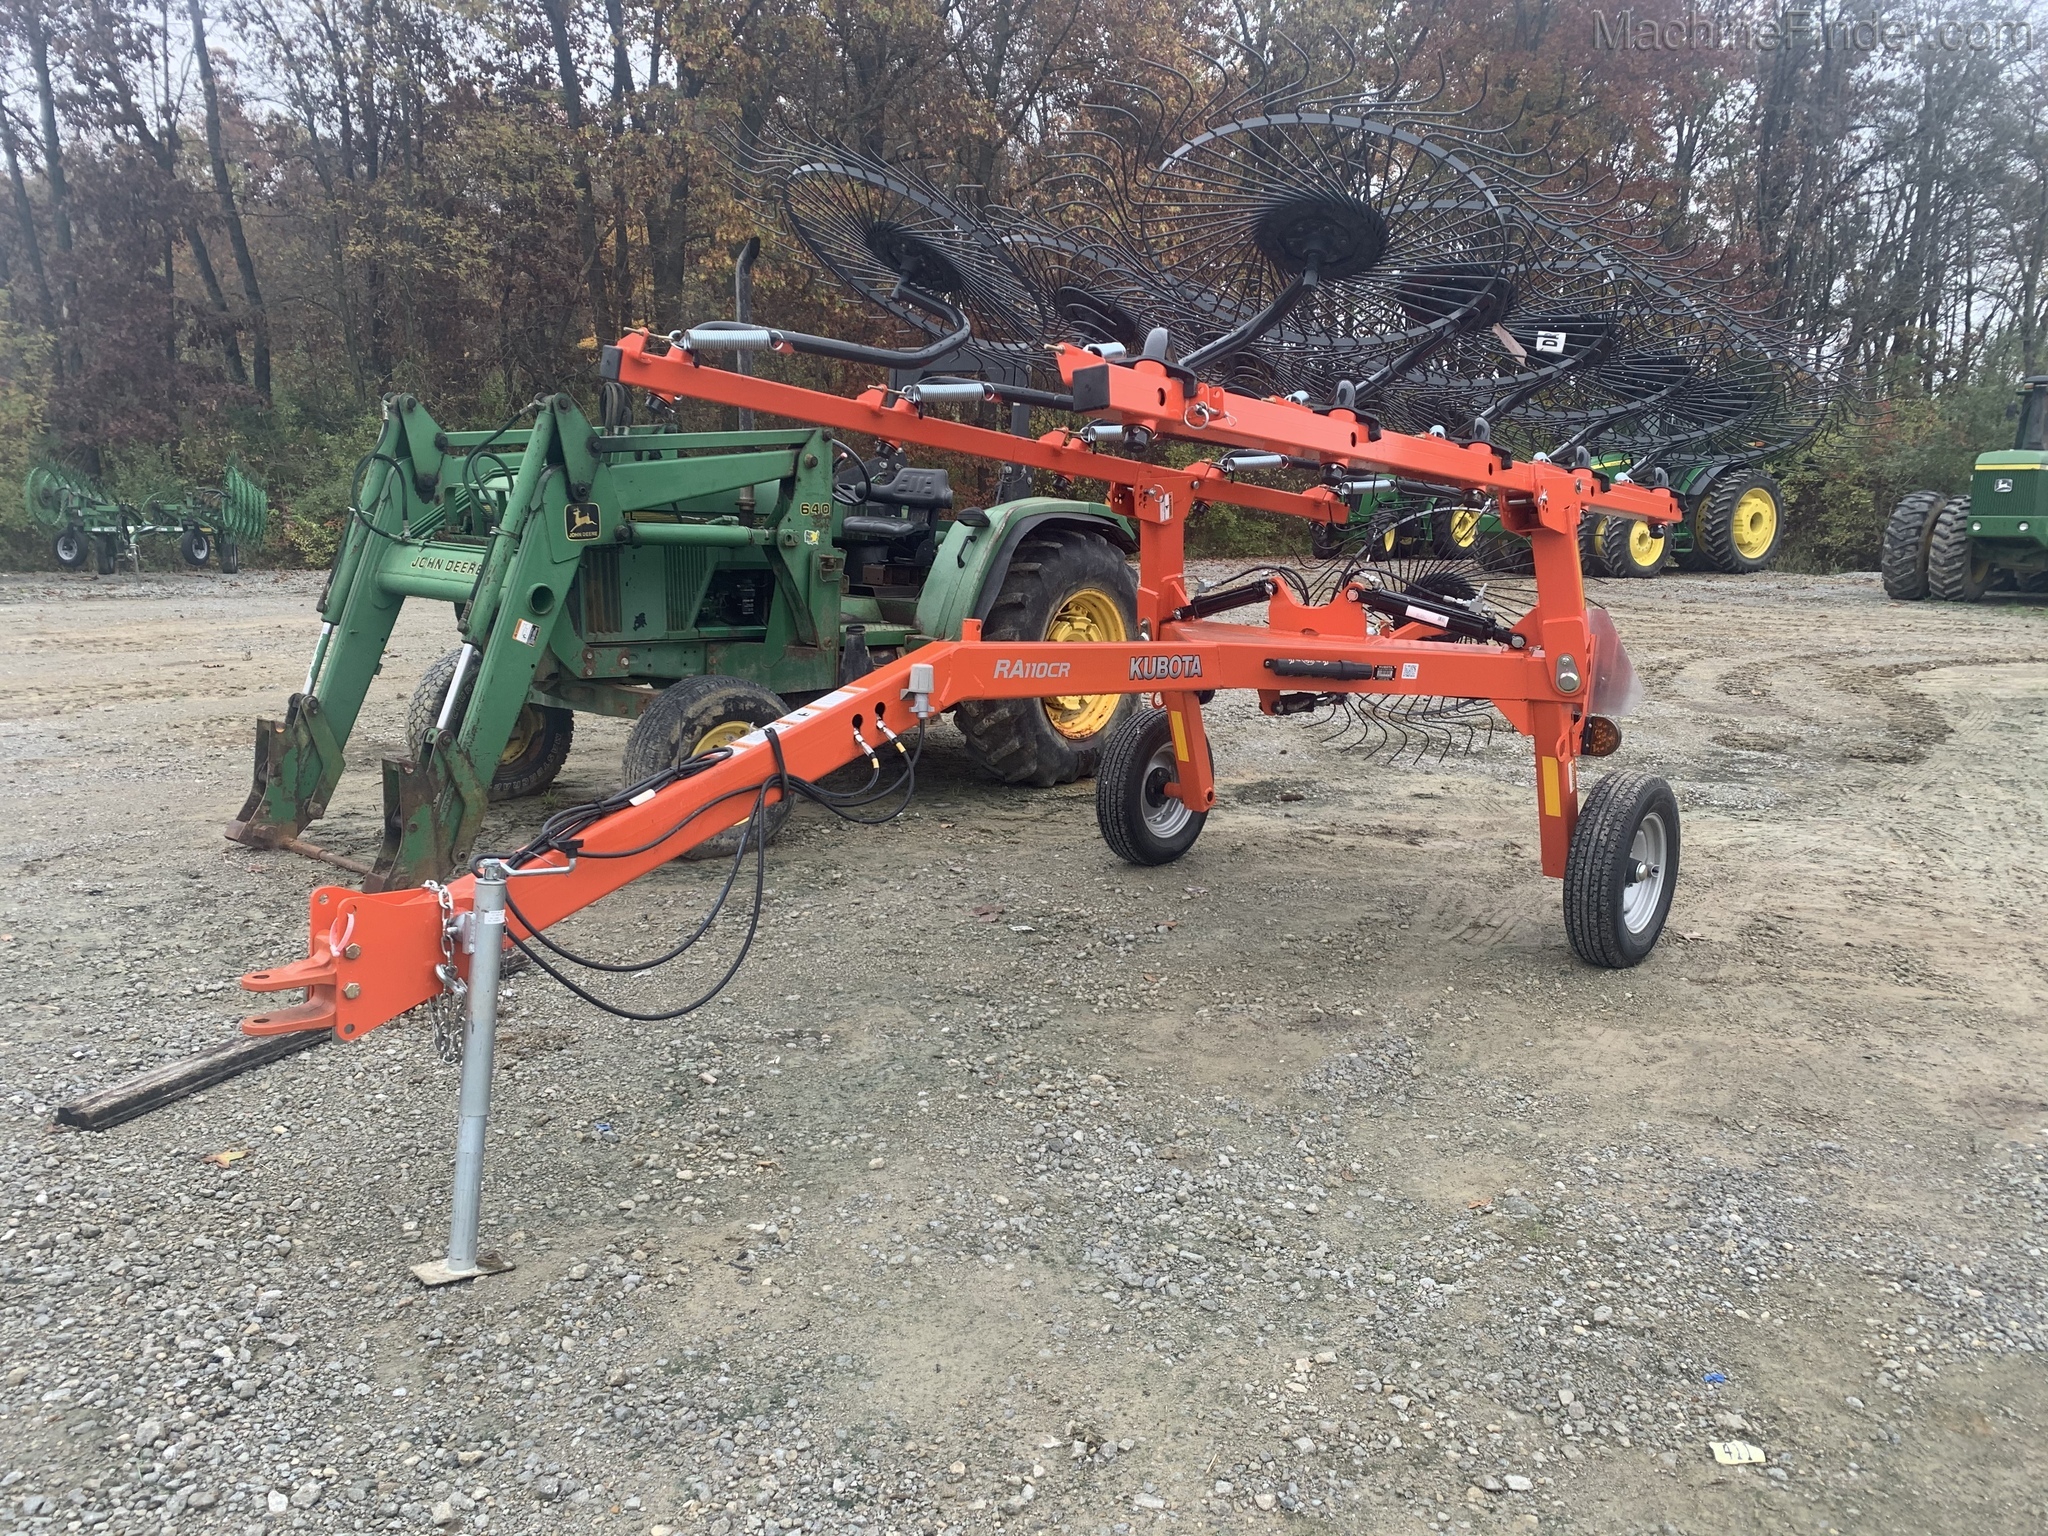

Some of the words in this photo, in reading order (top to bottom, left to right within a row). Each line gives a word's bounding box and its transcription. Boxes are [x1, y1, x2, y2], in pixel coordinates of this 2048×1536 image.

[800, 502, 831, 516] 640
[411, 556, 444, 570] JOHN
[993, 659, 1071, 679] RA110CR
[1129, 655, 1203, 681] KUBOTA
